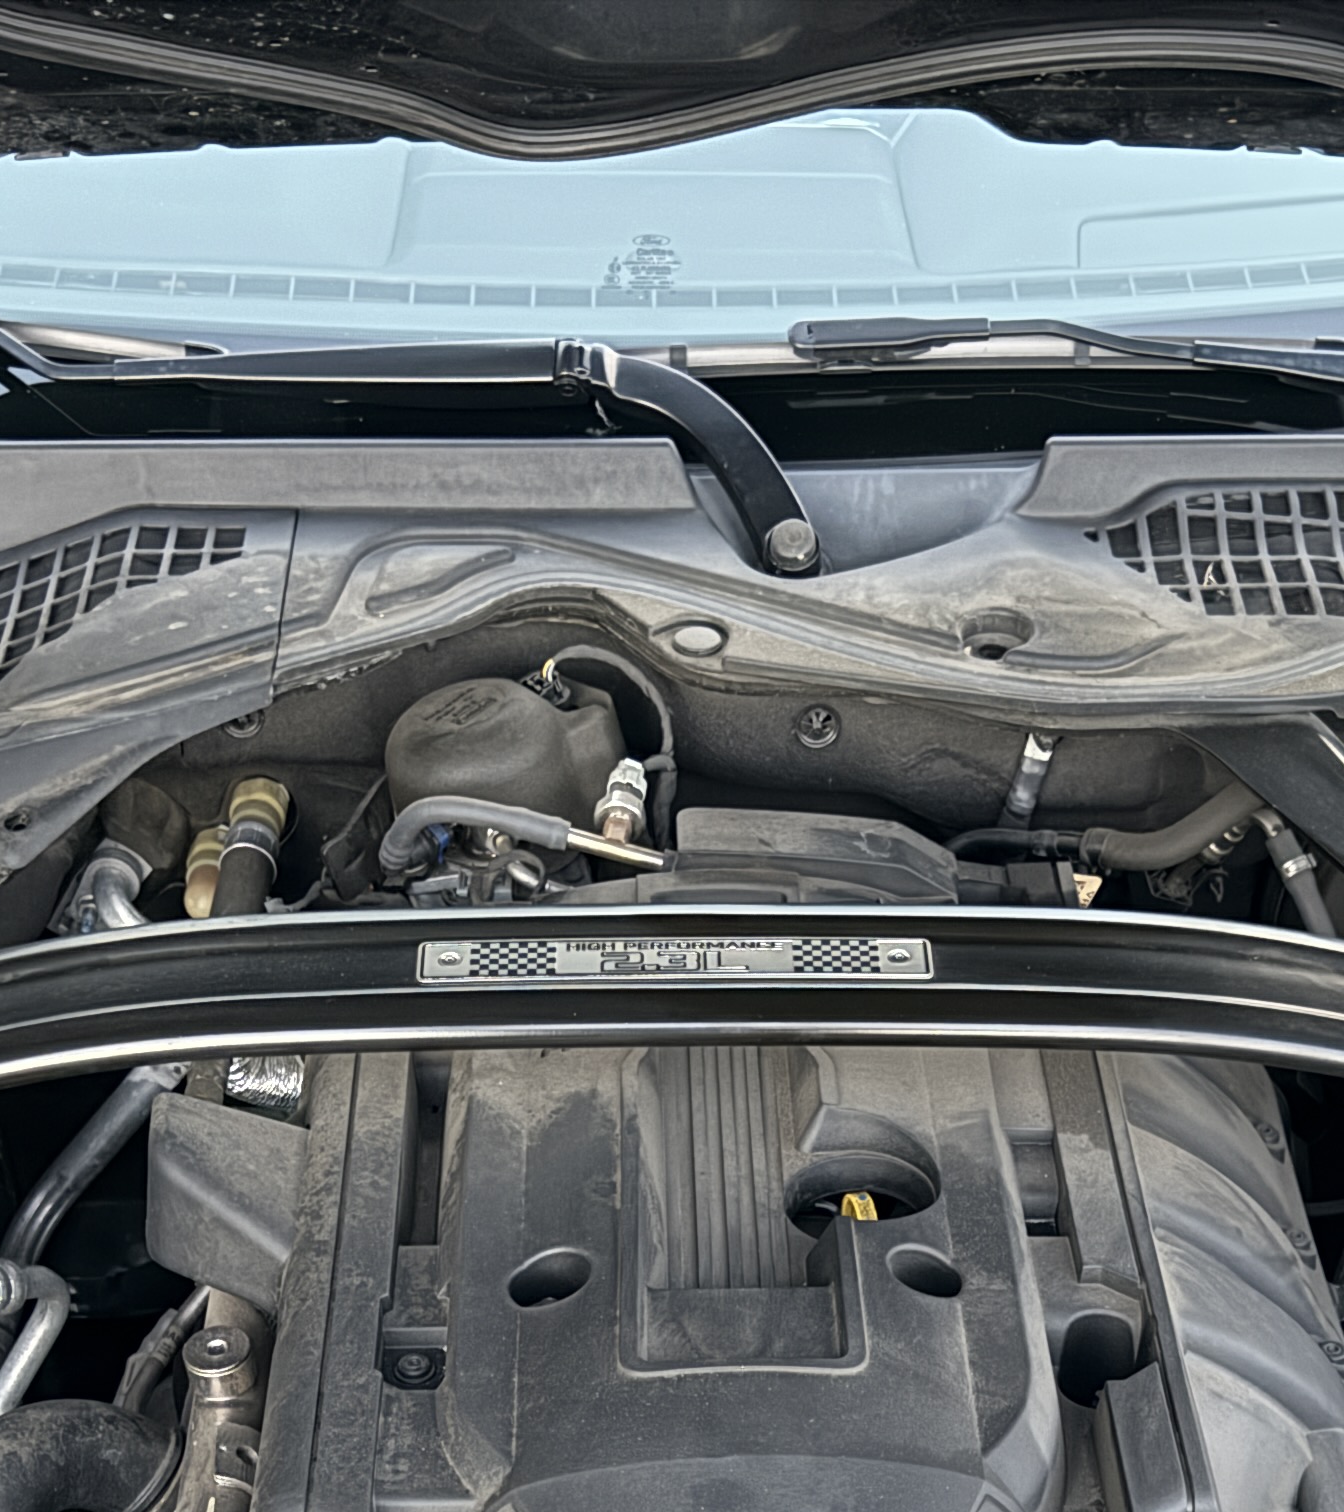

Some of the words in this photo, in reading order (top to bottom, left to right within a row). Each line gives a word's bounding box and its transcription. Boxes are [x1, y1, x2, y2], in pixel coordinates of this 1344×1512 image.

[566, 942, 615, 951] HIGH
[623, 941, 784, 951] PERFORMANCE
[600, 950, 750, 973] 2.3L
